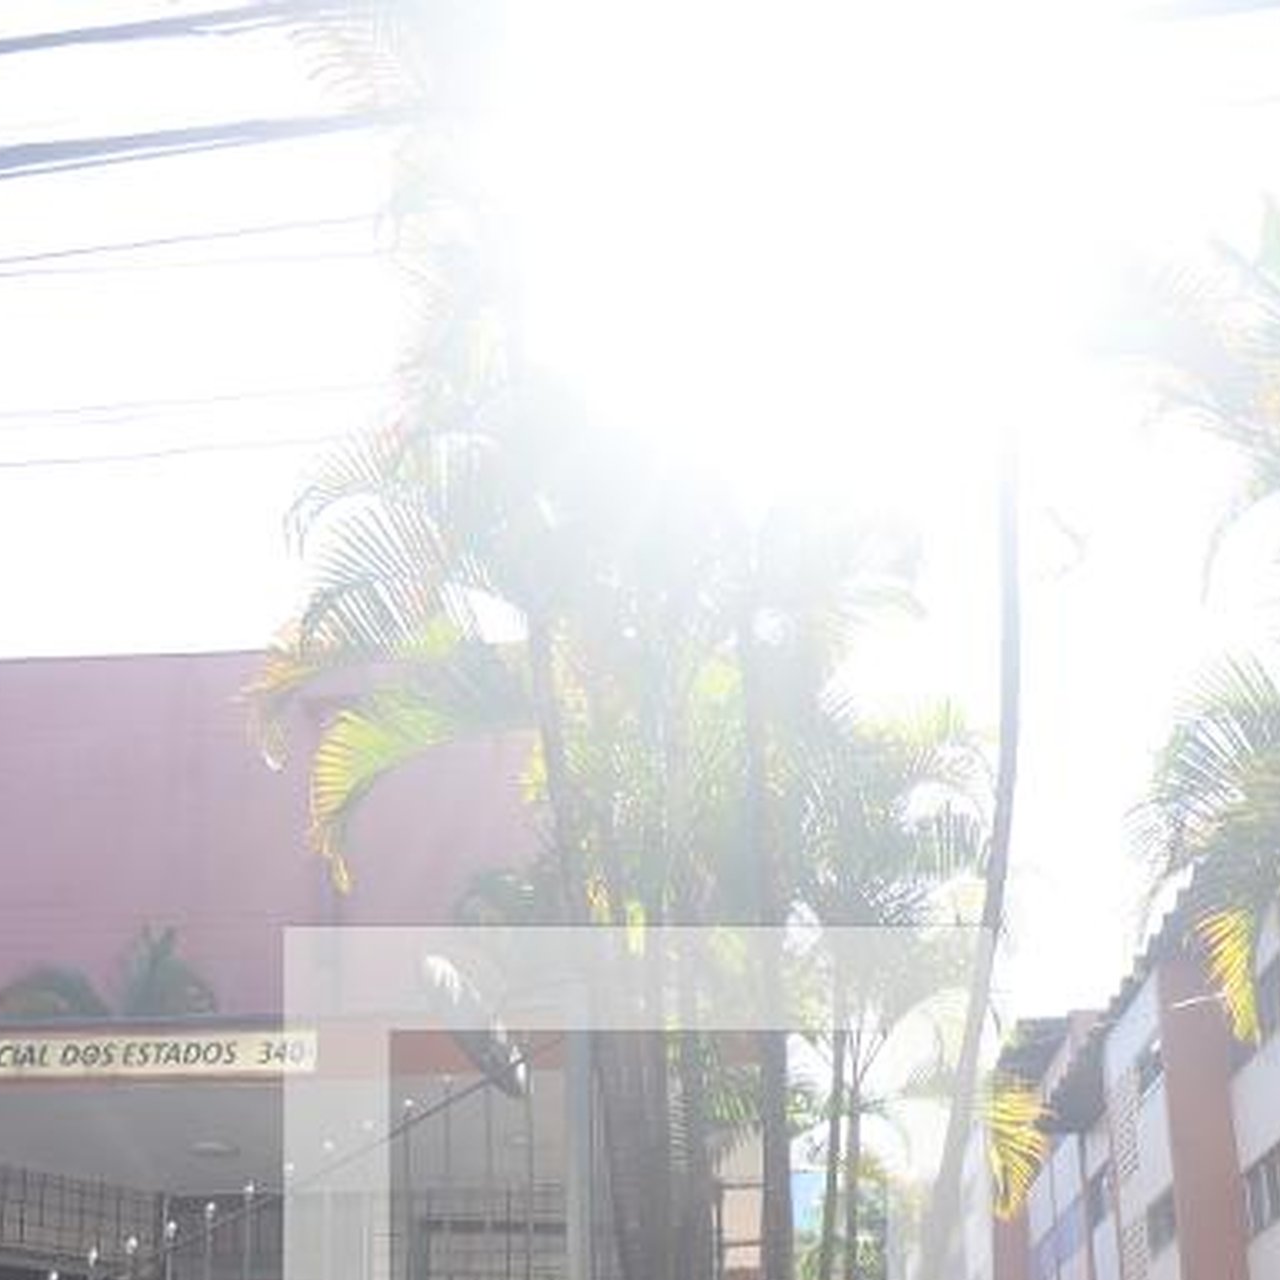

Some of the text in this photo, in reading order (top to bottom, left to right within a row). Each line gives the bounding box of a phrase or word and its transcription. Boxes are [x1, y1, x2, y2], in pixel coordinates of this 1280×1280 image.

[60, 1043, 117, 1067] DOS
[121, 1040, 237, 1066] ESTADOS
[257, 1039, 305, 1064] 340
